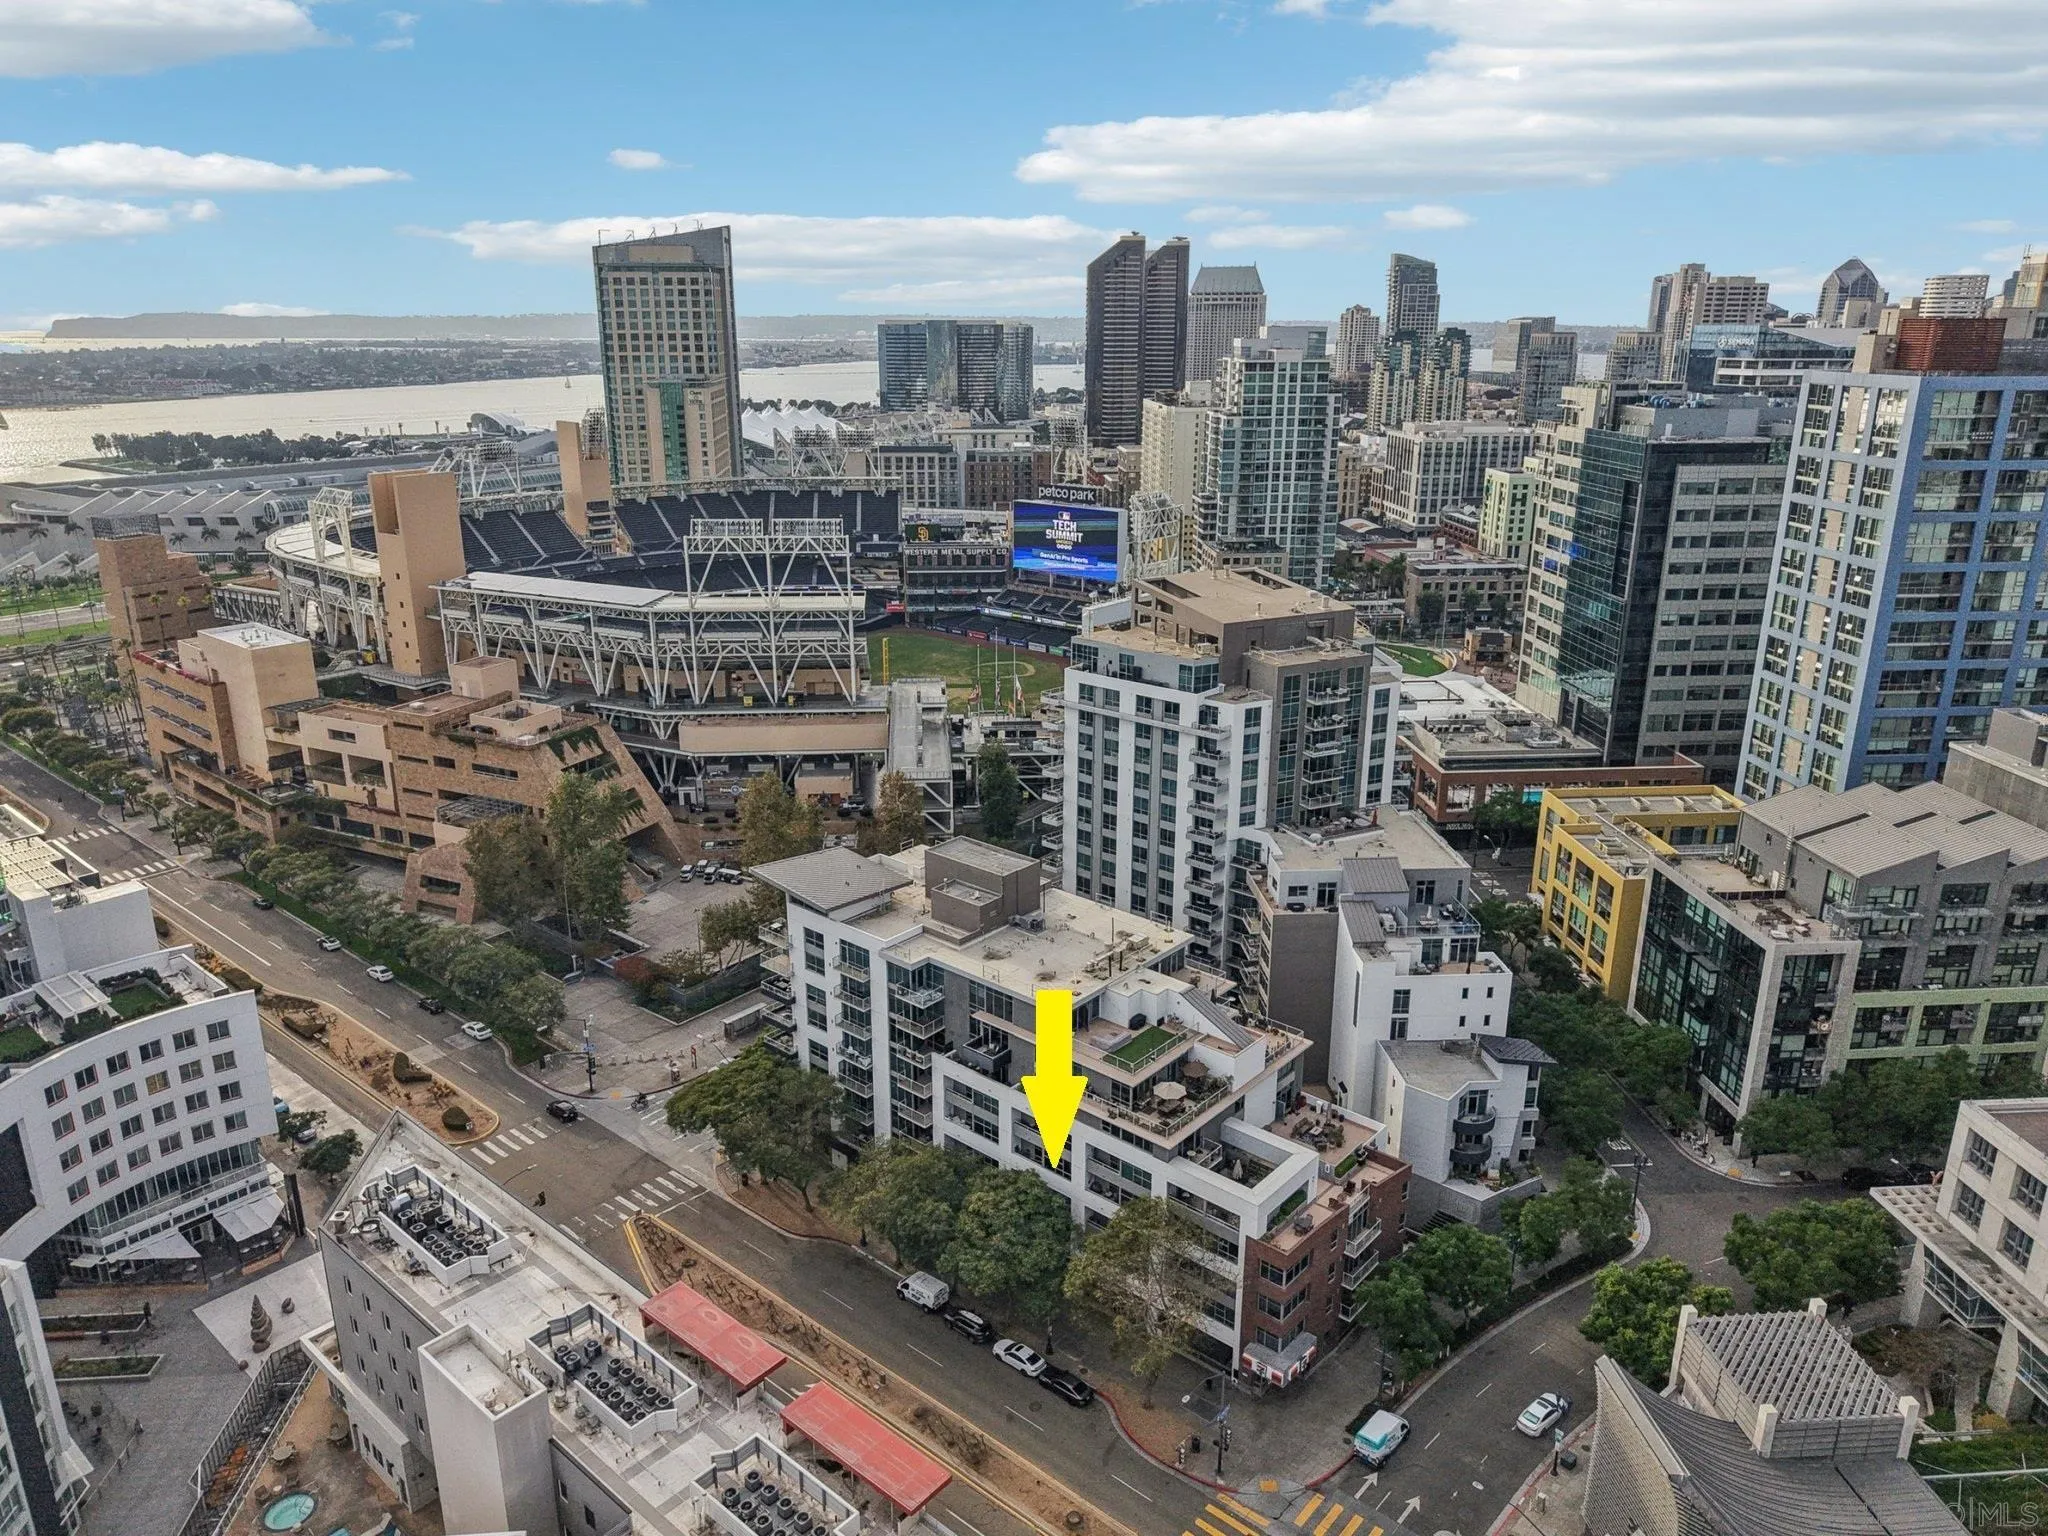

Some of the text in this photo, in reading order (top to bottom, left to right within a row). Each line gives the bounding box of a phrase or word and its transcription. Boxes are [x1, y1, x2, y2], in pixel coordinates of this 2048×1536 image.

[1038, 486, 1095, 502] petco park
[1052, 519, 1077, 532] TECH
[1045, 528, 1084, 543] SUMMIT
